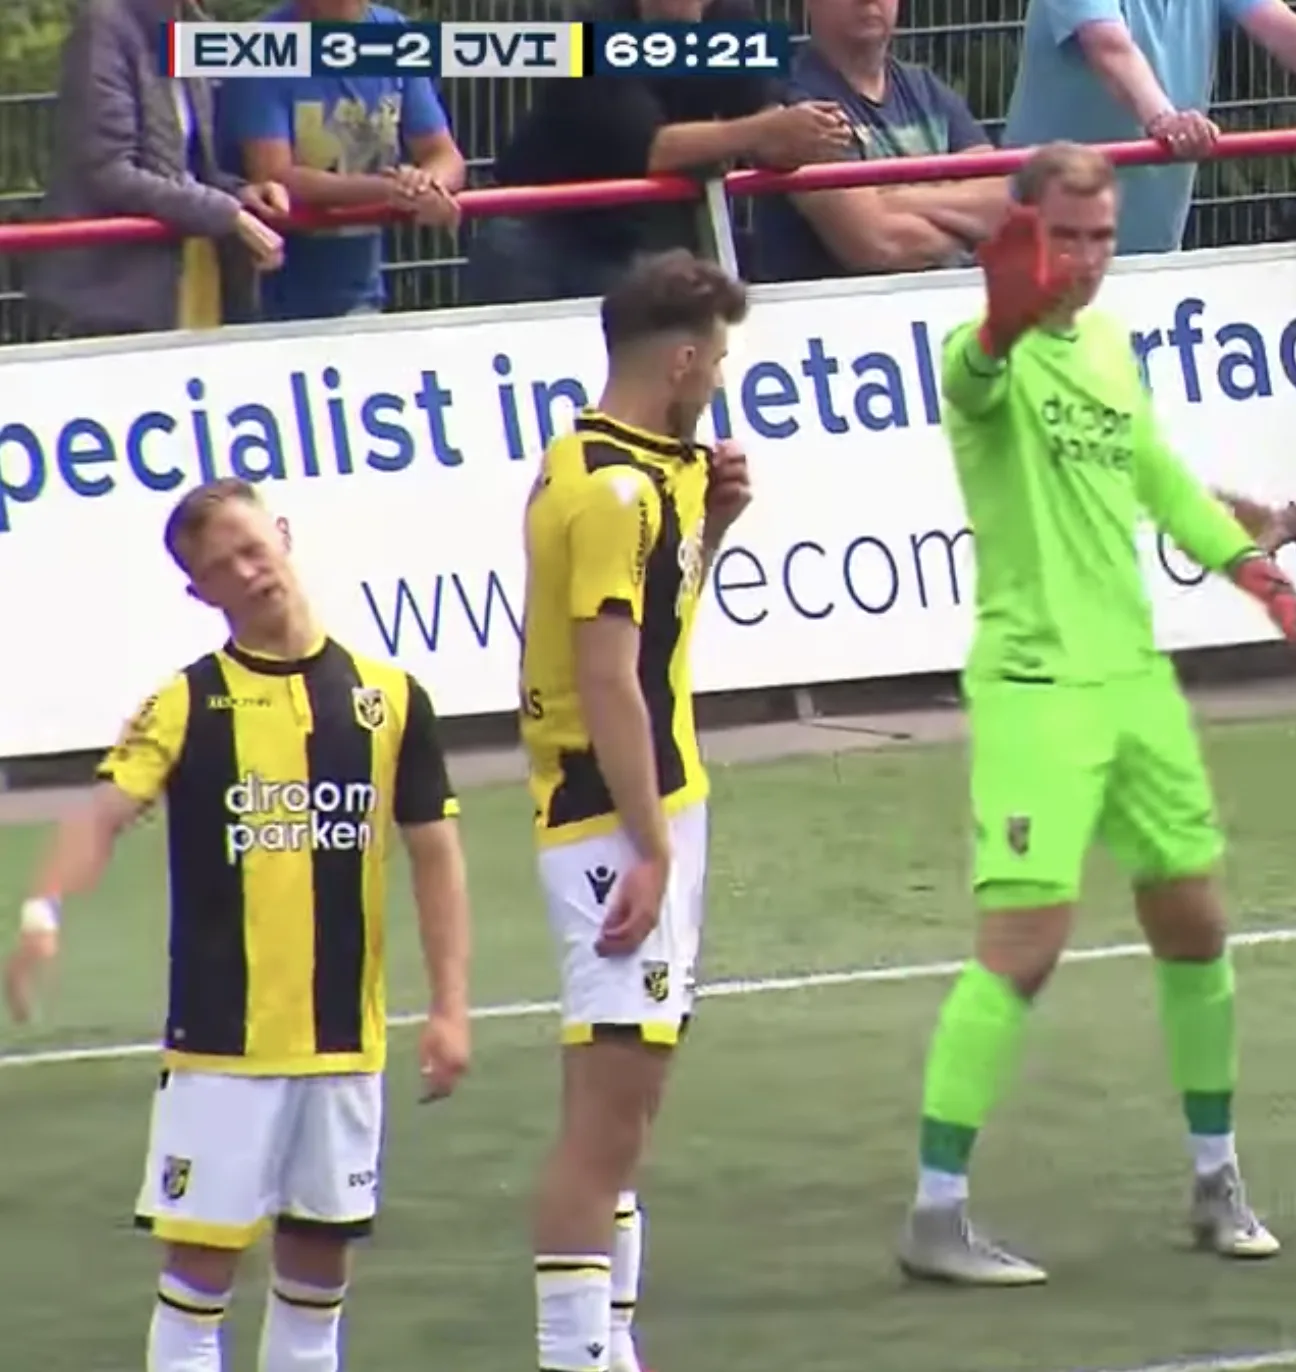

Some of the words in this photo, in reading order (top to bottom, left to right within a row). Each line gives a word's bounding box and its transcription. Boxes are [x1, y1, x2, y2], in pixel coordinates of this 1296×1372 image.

[710, 321, 942, 440] etal
[225, 771, 377, 814] droom
[225, 808, 372, 866] parken
